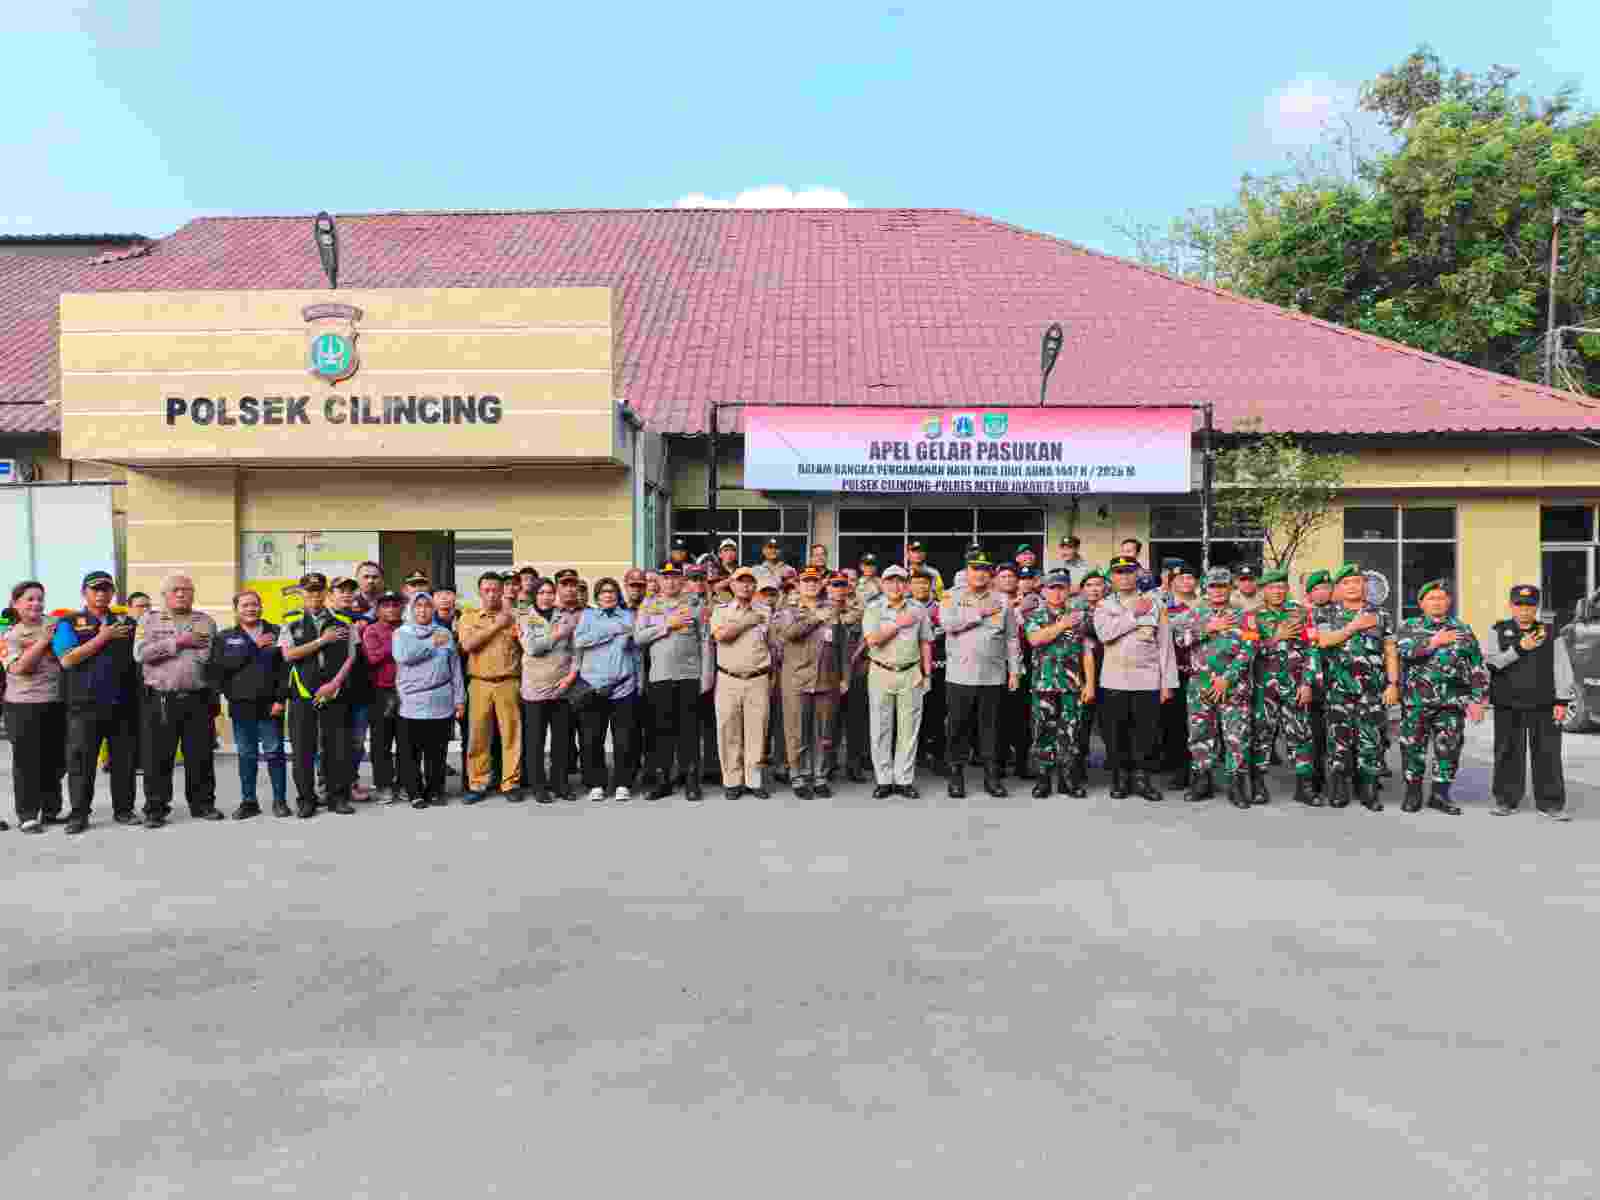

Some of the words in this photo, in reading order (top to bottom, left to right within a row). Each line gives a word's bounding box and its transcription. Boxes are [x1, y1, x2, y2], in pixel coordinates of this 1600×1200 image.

[166, 395, 312, 426] POLSEK
[323, 395, 503, 425] CILINCING
[869, 441, 911, 461] APEL
[916, 441, 972, 461] GELAR
[976, 441, 1063, 461] PASUKAN
[841, 479, 880, 491] POLSEK
